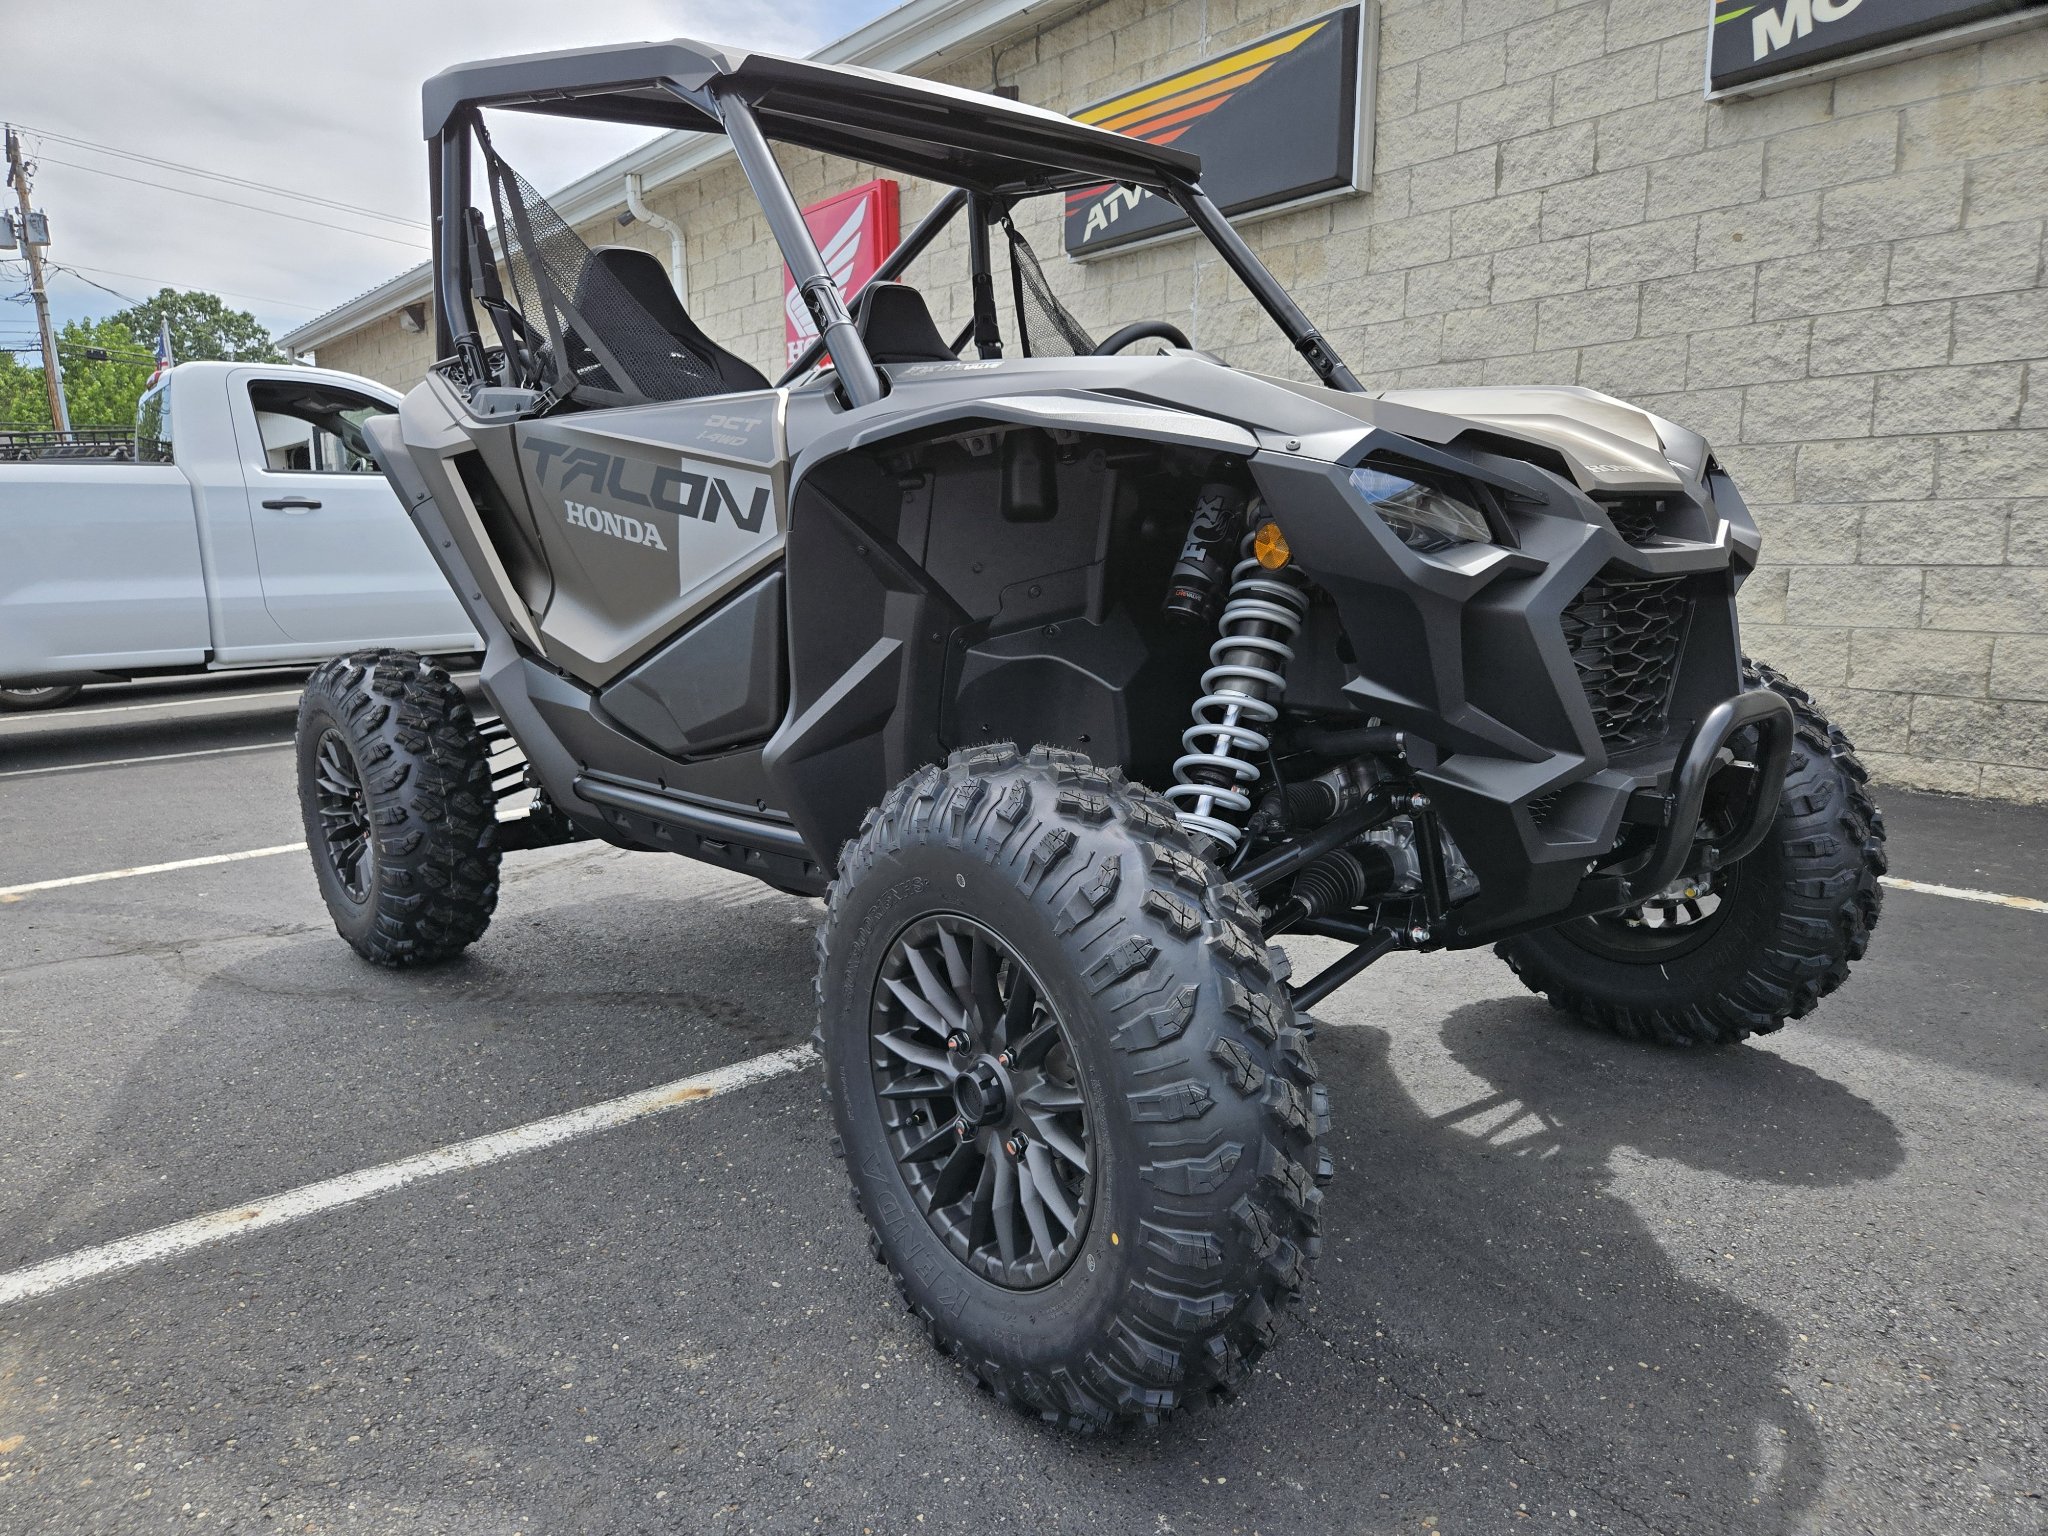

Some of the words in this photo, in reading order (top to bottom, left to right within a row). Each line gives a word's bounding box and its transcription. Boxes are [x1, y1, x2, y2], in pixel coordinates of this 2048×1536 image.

[1083, 185, 1153, 243] ATV
[704, 414, 763, 432] DCT
[523, 436, 771, 534] TALON
[564, 500, 668, 551] HONDA
[1180, 495, 1225, 561] FOX
[862, 1152, 971, 1318] KENDA
